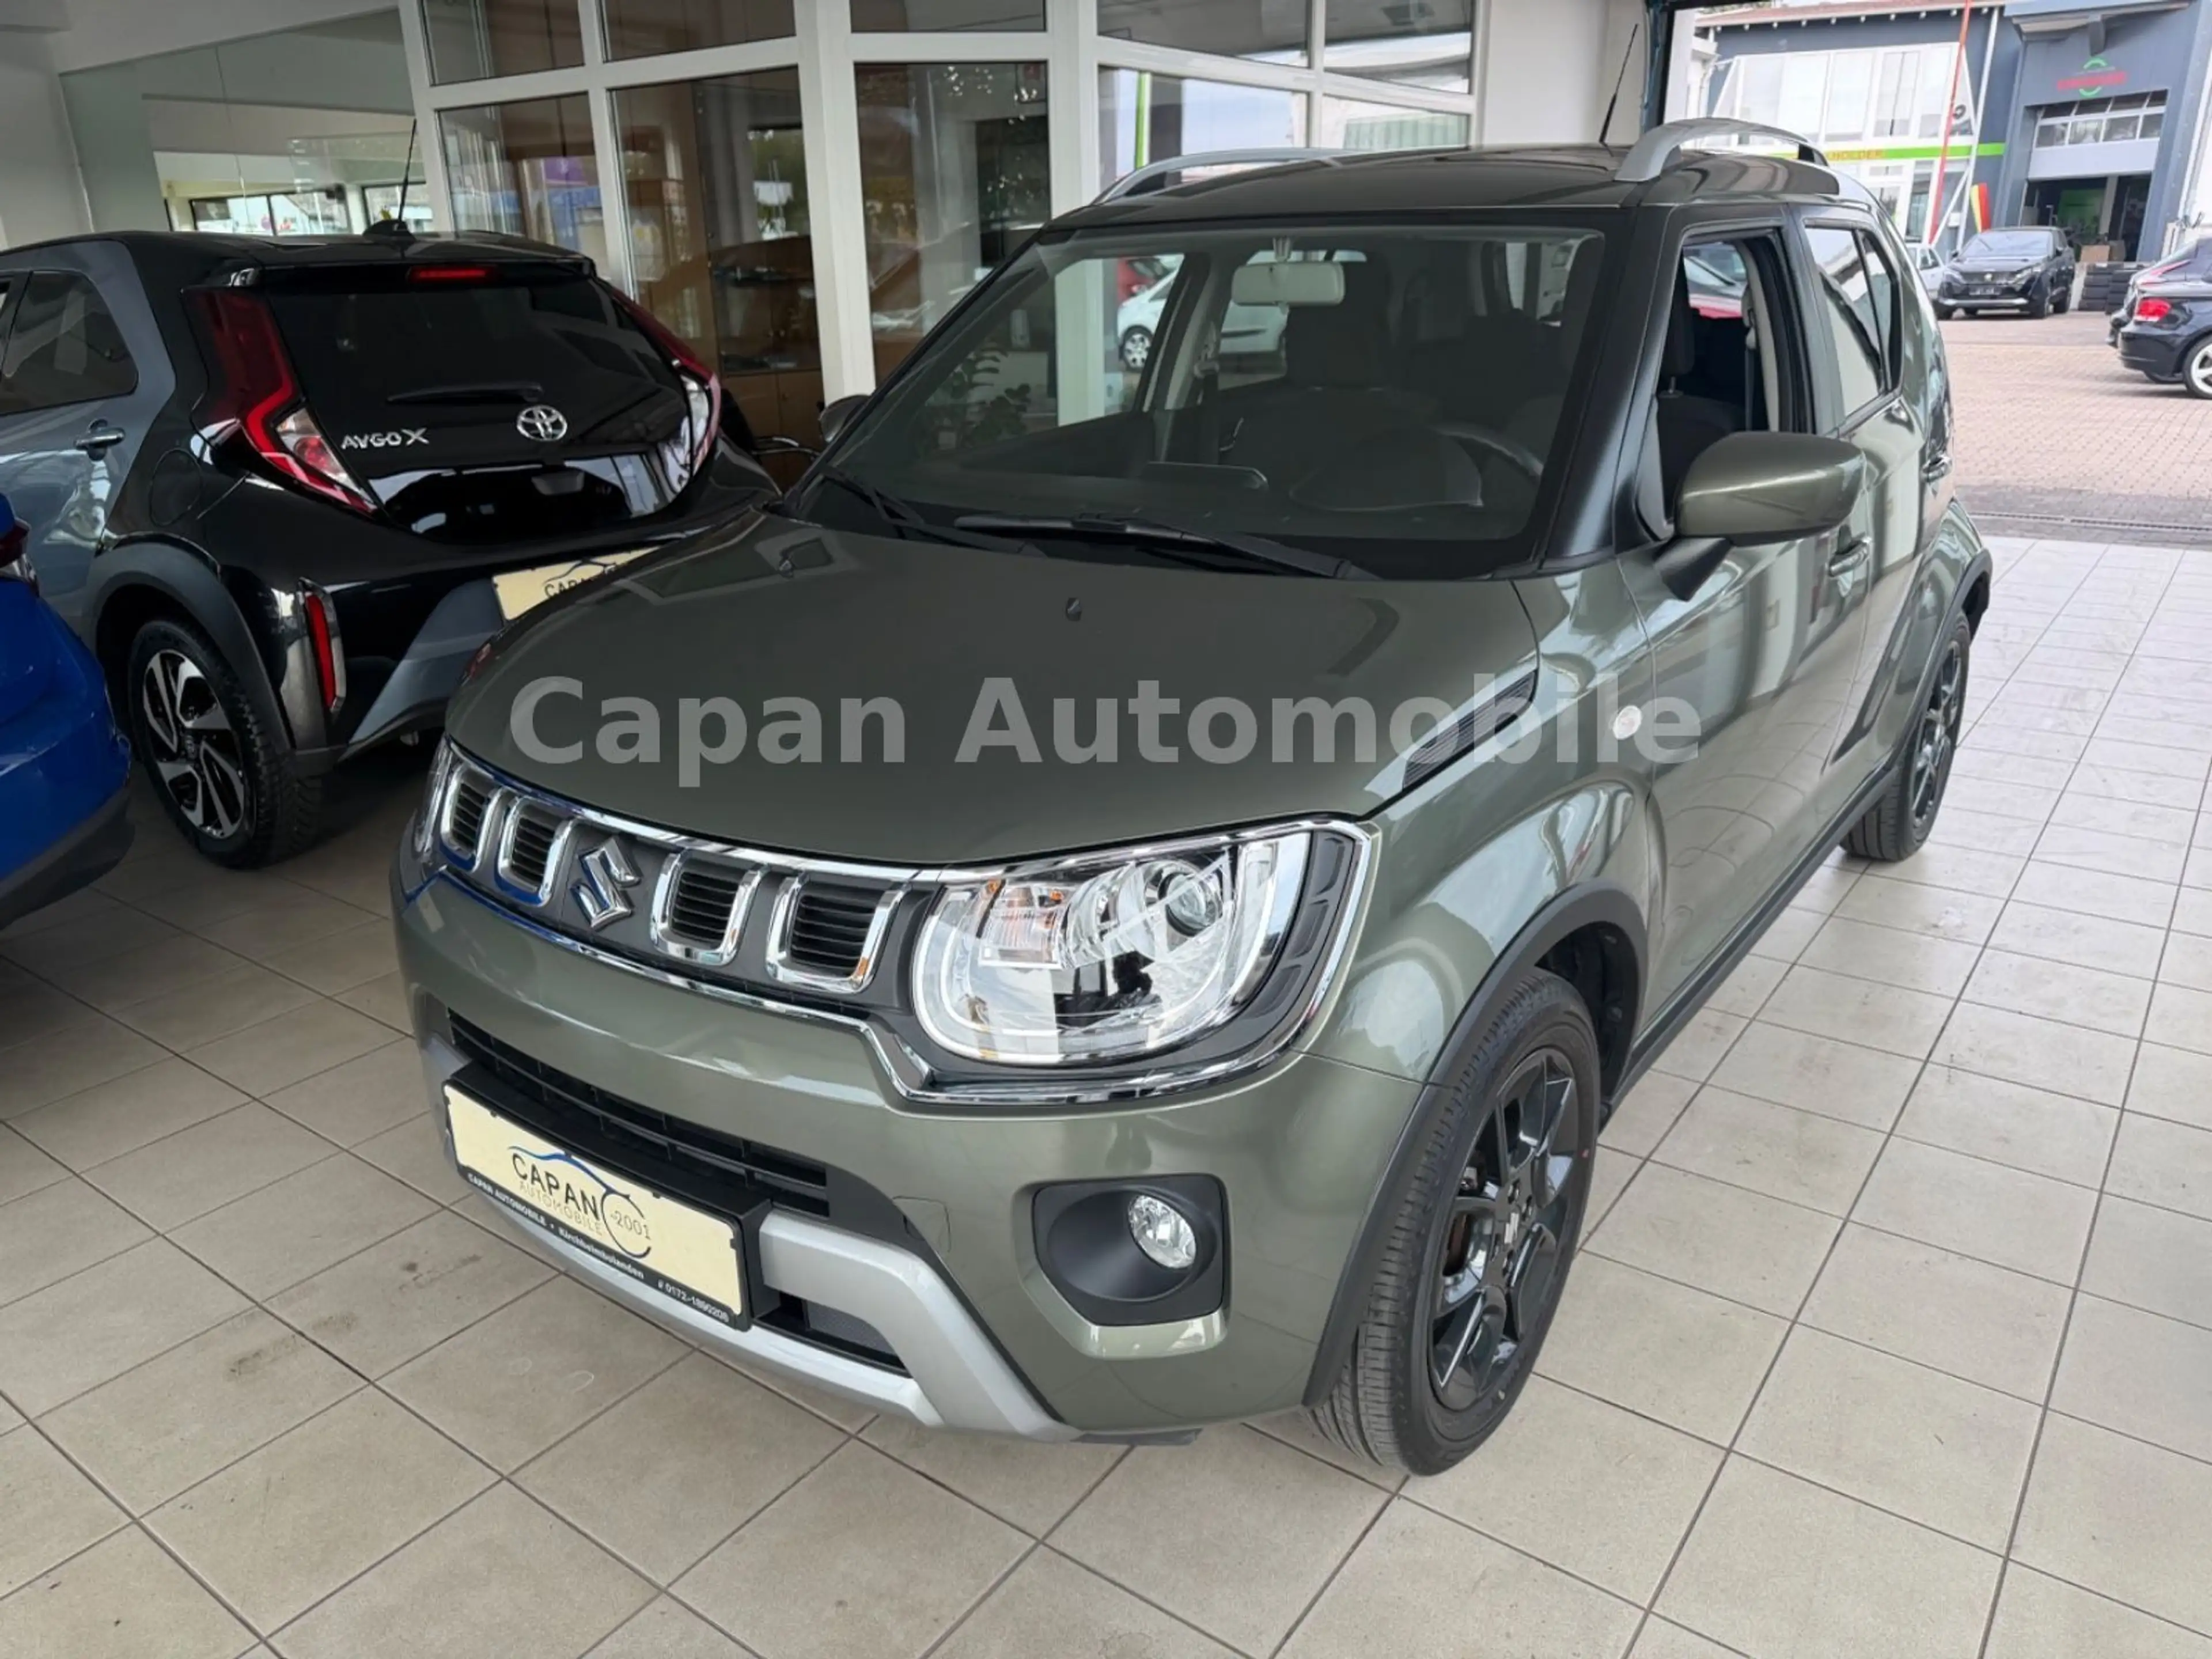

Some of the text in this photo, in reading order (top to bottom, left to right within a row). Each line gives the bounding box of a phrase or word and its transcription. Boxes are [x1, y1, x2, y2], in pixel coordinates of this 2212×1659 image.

[401, 427, 429, 446] X
[512, 1153, 600, 1221] CAPAN
[520, 1180, 603, 1236] AUTOMOBILE
